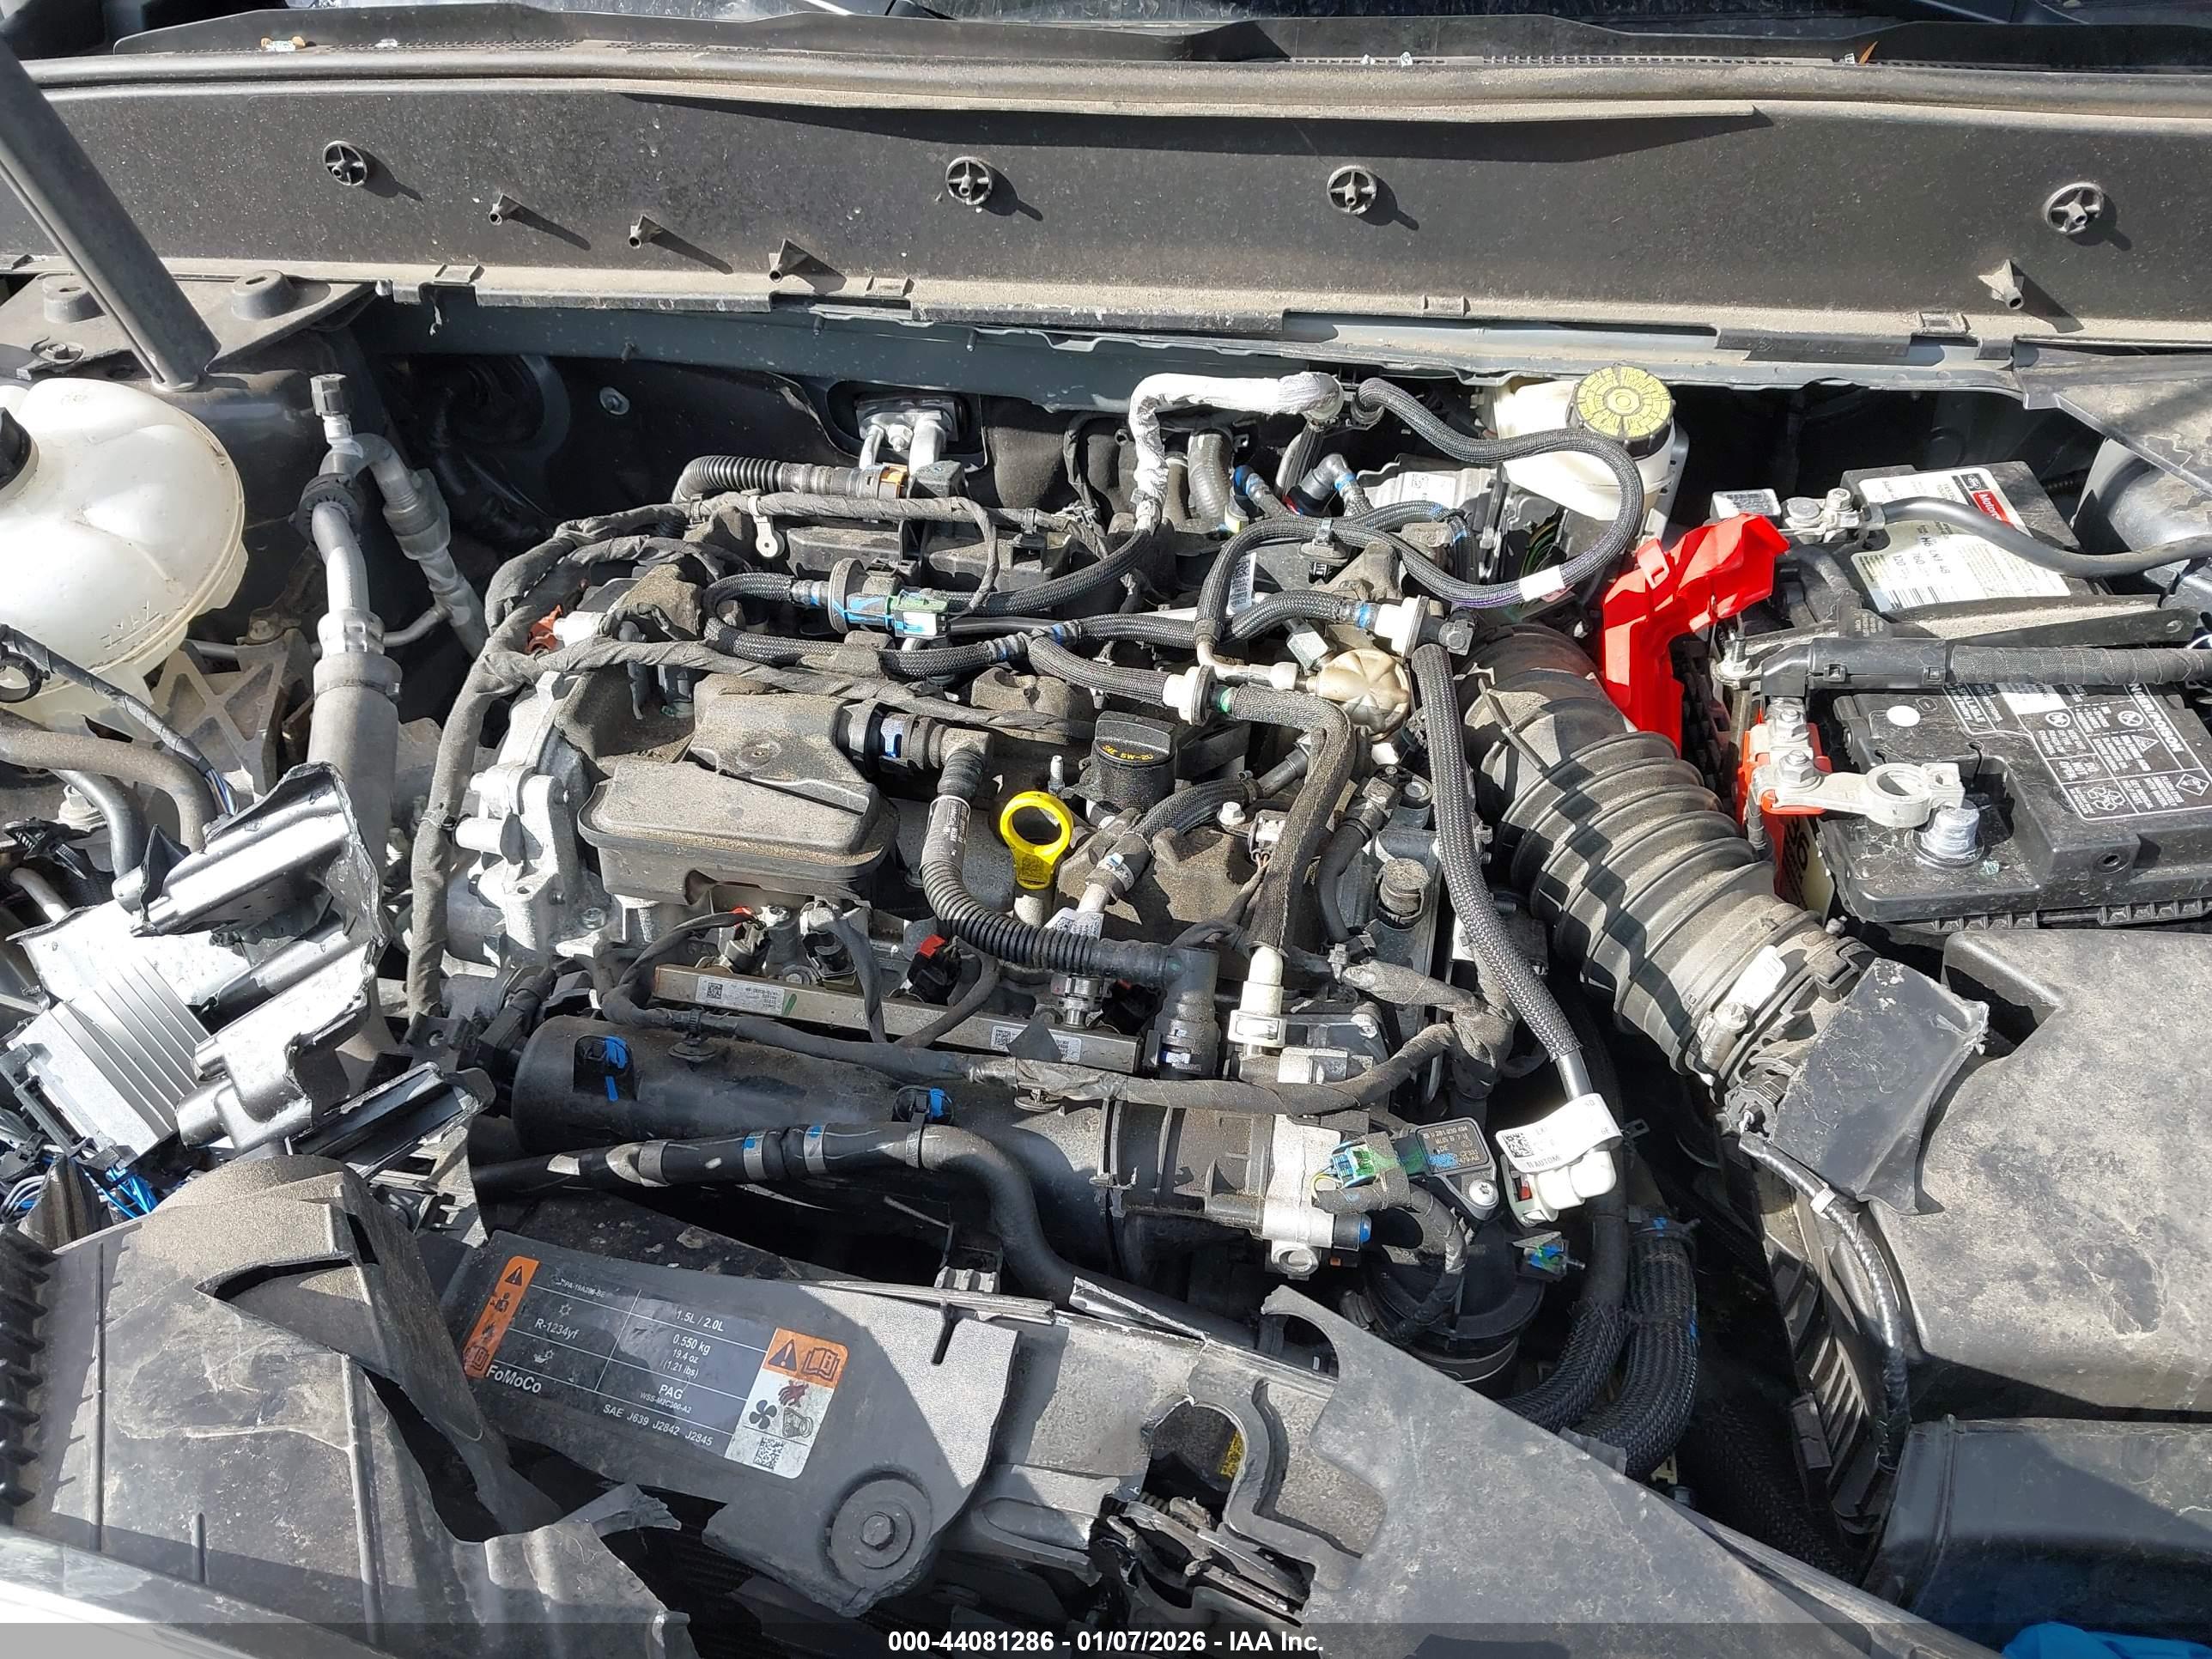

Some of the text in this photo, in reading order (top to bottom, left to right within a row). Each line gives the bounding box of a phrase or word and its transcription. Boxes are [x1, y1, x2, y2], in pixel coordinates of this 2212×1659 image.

[1978, 493, 2002, 521] Motorc
[1954, 684, 1986, 723] -SPILLABLE
[2084, 712, 2101, 729] FLAMES
[2129, 683, 2185, 753] NGER/POISON
[1102, 744, 1118, 755] SAE
[2101, 738, 2124, 762] BLINDNESS
[2071, 762, 2089, 775] NOT
[2084, 763, 2100, 772] DO
[534, 1318, 580, 1340] R-1234yf
[677, 1310, 724, 1332] 1.5L / 2.0L
[672, 1334, 711, 1356] 0.550 kg
[672, 1348, 699, 1364] 19.4 oz
[485, 1364, 542, 1393] FoMoCo
[663, 1359, 699, 1379] (1.21 lbs)
[640, 1392, 692, 1413] WSS-M2C300-A2
[659, 1383, 684, 1400] PAG
[603, 1404, 714, 1446] SAE J639 J2842 J2845
